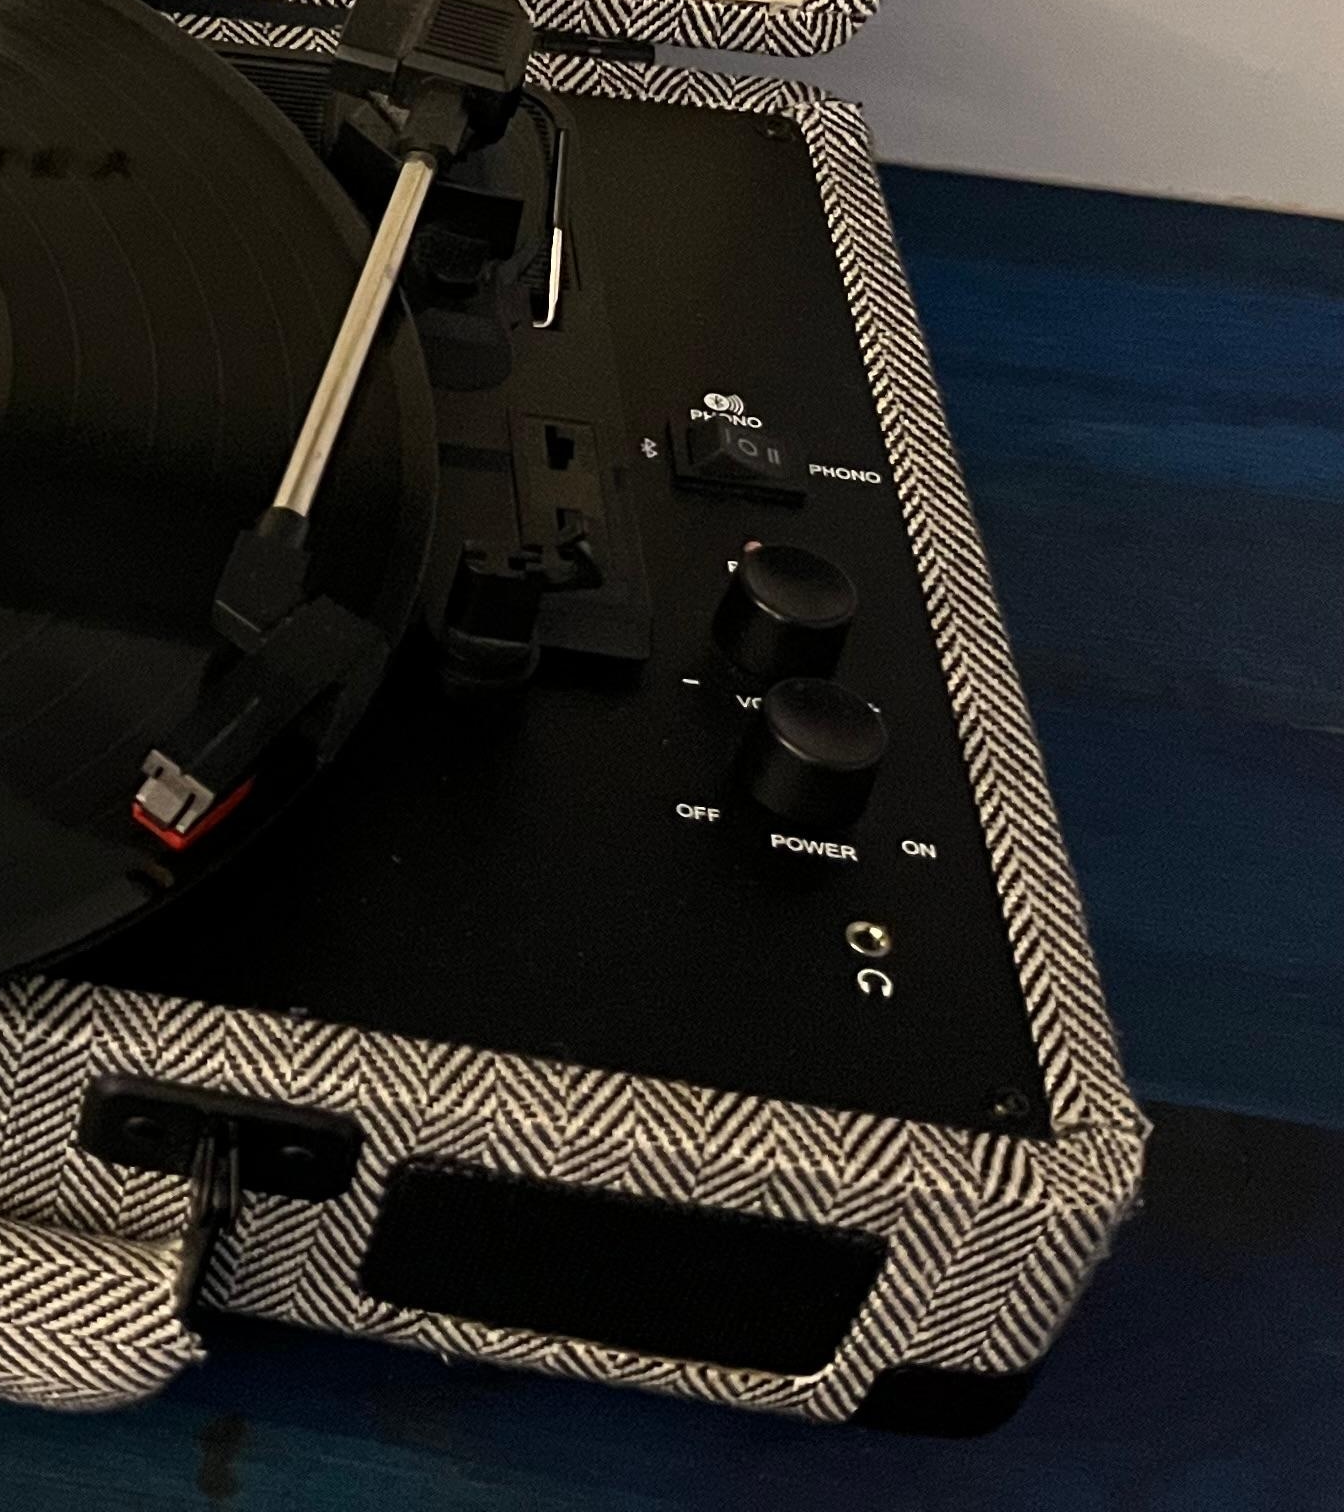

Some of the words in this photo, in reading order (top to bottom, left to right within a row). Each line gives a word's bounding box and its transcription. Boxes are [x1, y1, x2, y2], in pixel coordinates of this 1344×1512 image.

[809, 464, 882, 484] PHONO
[676, 803, 720, 822] OFF
[770, 834, 858, 862] POWER
[901, 840, 937, 858] ON
